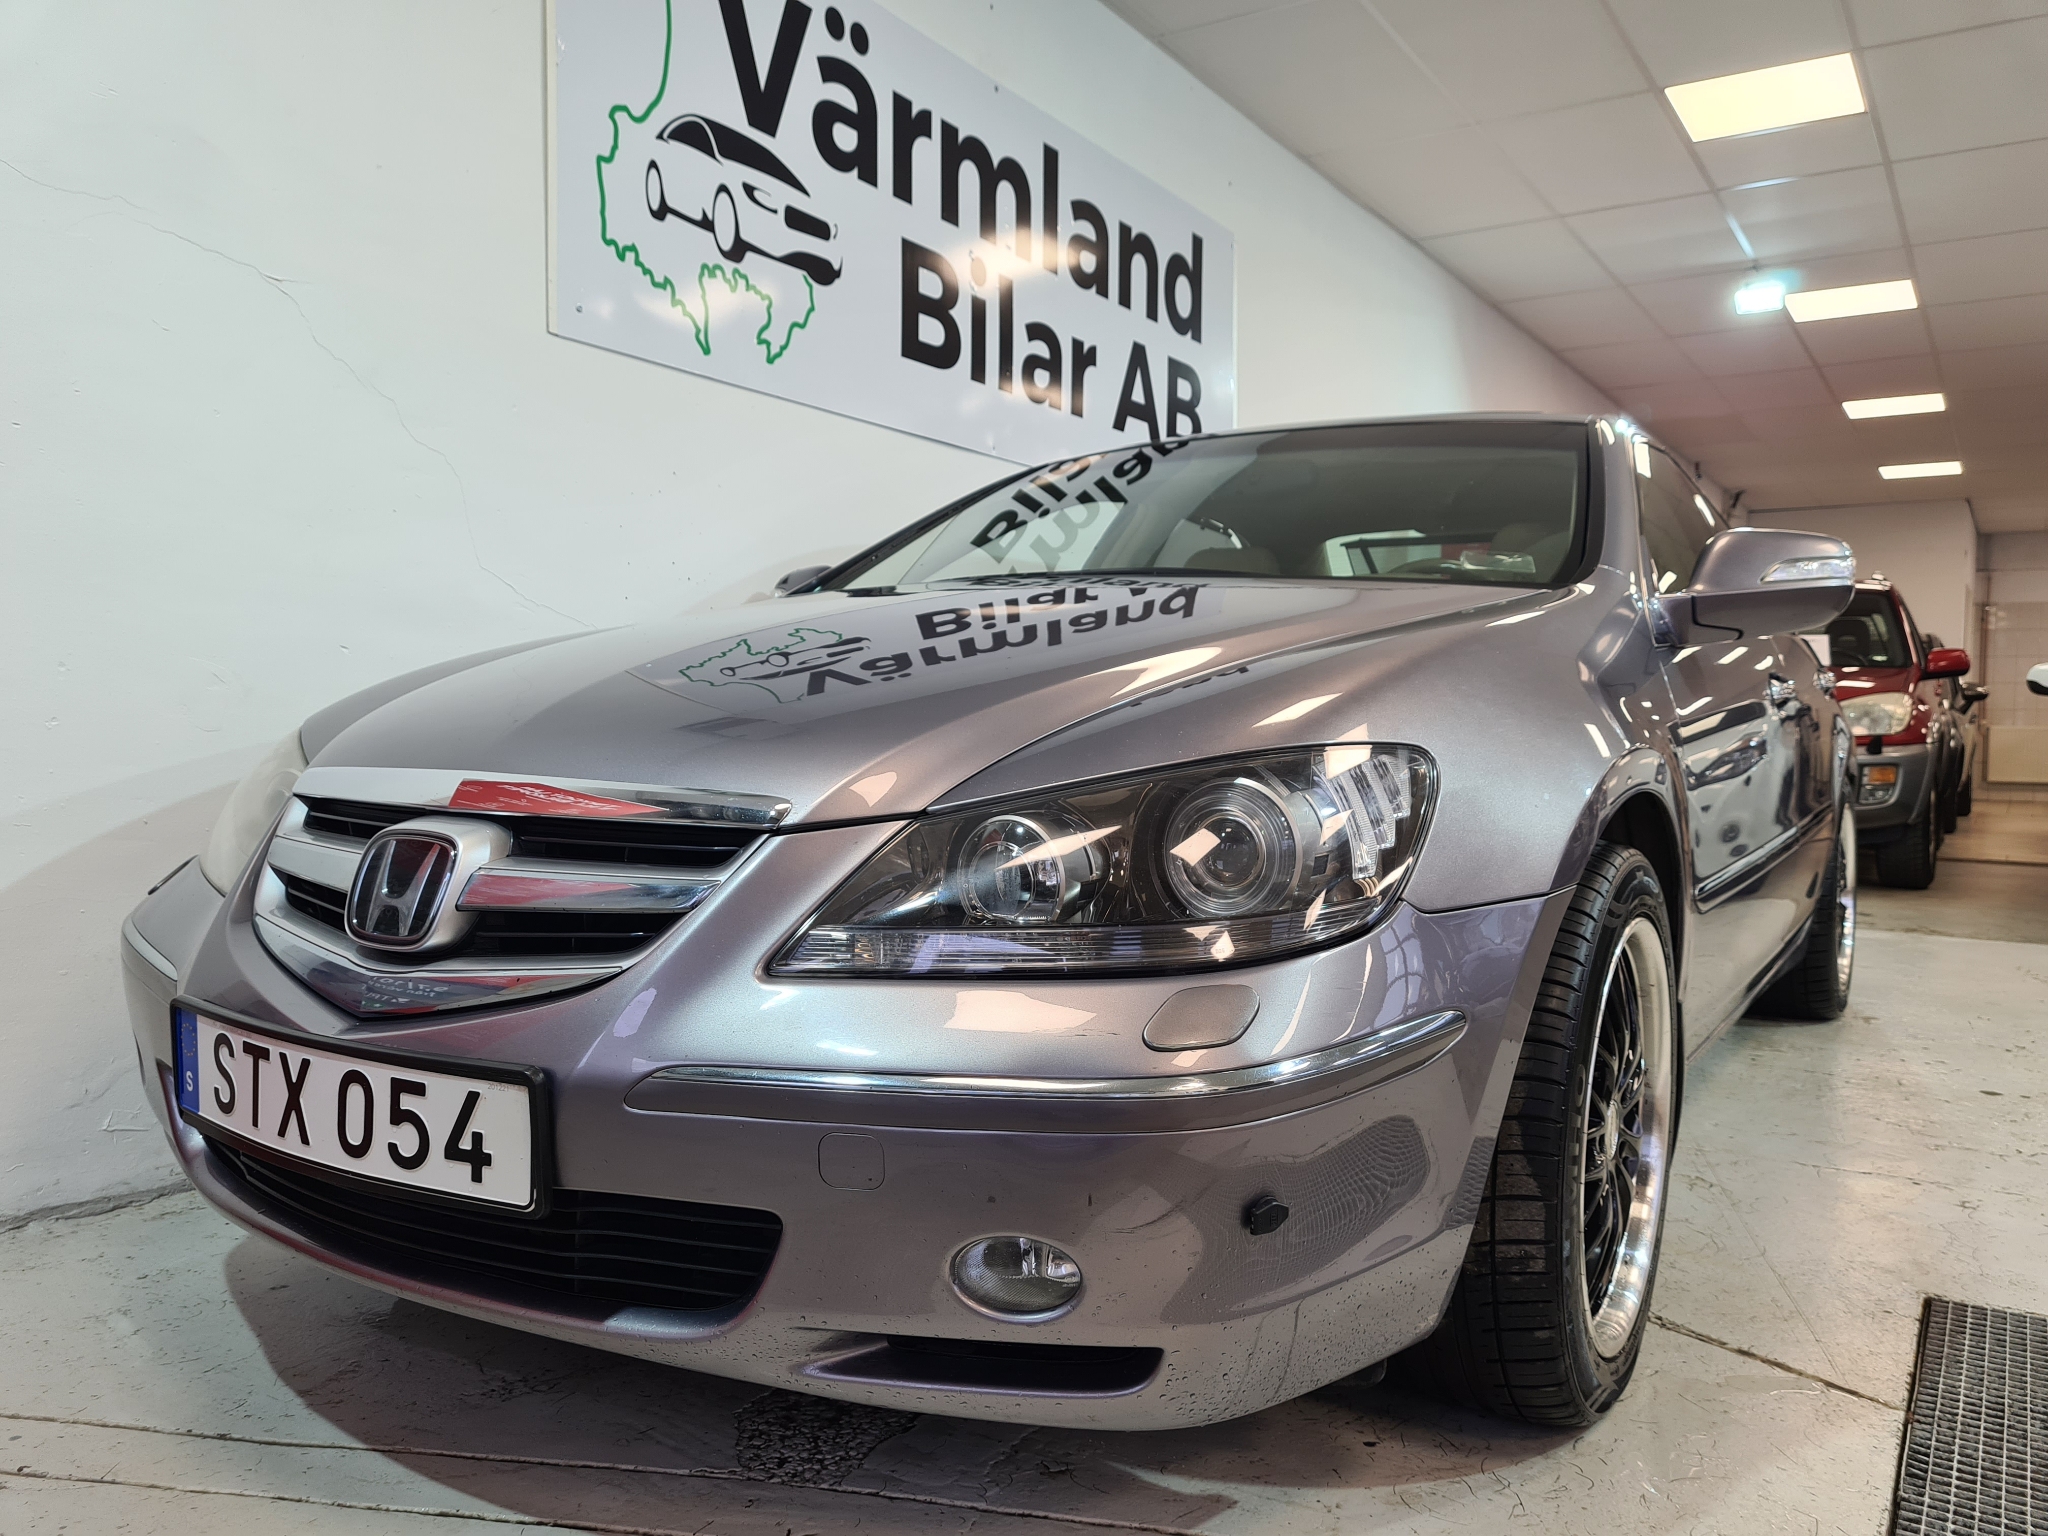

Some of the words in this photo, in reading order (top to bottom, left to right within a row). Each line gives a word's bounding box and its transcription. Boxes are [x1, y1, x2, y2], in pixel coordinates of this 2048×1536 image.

[718, 0, 1203, 344] Värmland
[900, 236, 1097, 418] Bilar
[1112, 341, 1203, 441] AB
[186, 1070, 194, 1092] S
[213, 1032, 311, 1147] STX
[337, 1068, 492, 1184] 054
